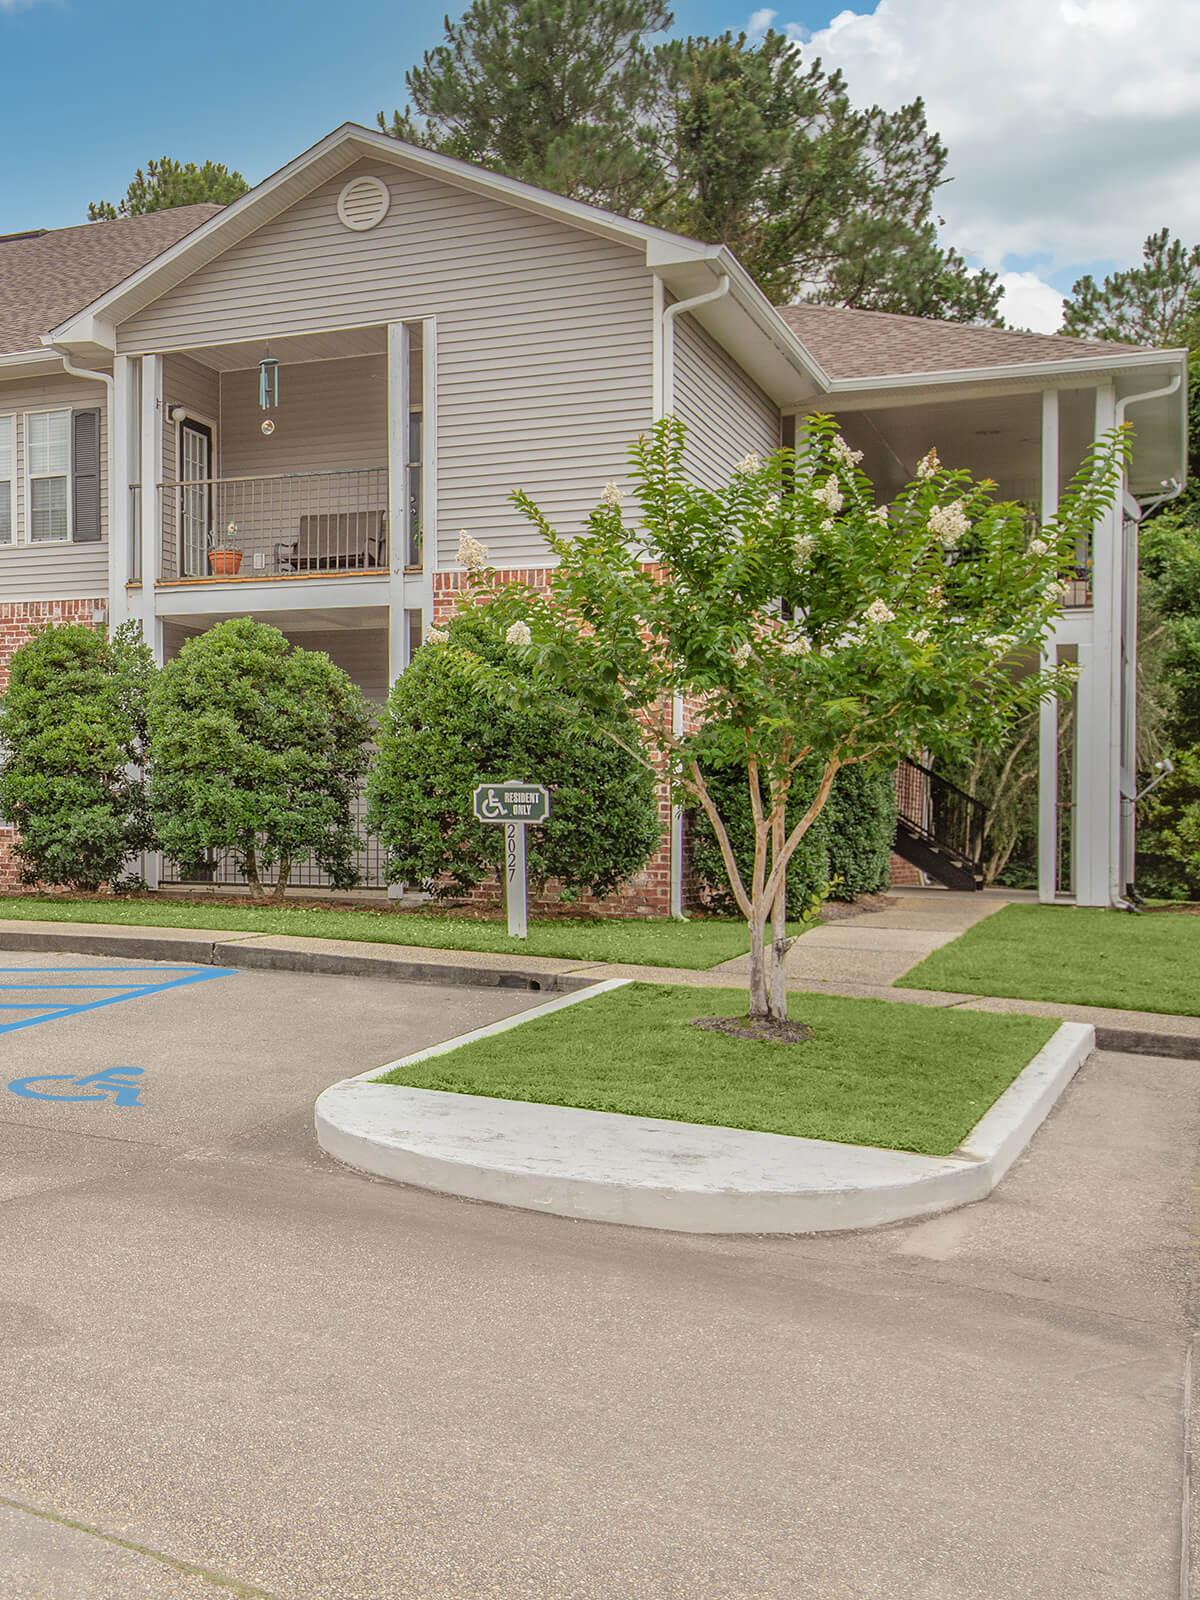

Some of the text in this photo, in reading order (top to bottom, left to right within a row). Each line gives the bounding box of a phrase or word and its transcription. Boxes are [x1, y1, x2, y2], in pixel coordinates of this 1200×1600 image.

[504, 792, 540, 803] RESIDENT
[512, 804, 532, 815] ONLY
[507, 824, 516, 883] 2027
